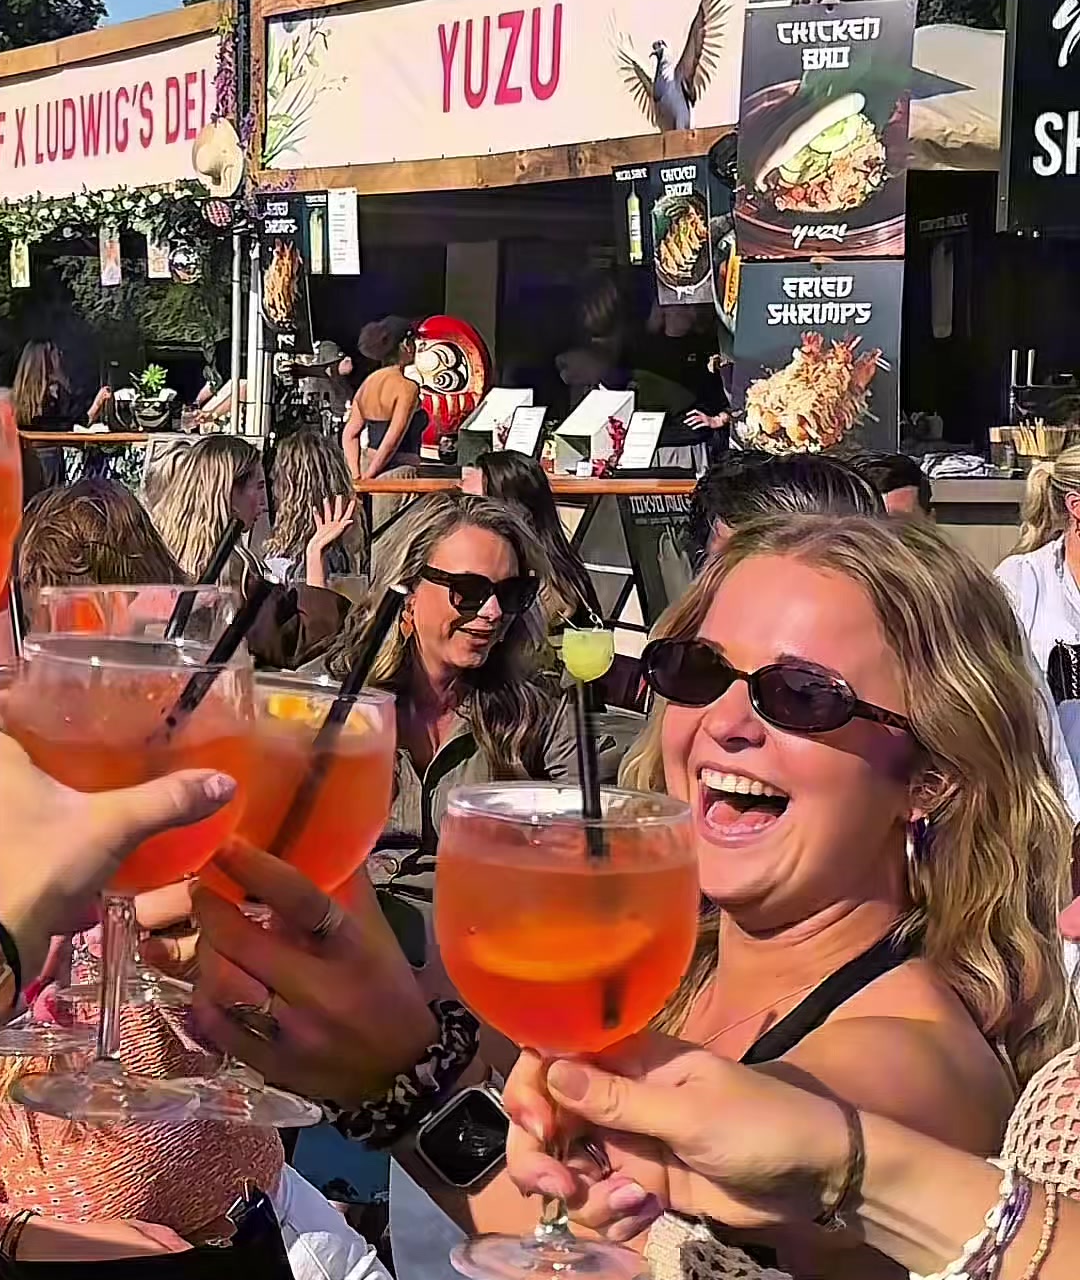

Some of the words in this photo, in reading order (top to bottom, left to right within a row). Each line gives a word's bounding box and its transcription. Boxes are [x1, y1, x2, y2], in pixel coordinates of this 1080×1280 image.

[777, 16, 880, 44] CHICKEN
[437, 3, 563, 113] YUZU
[801, 45, 850, 71] BAO
[14, 107, 26, 168] X
[35, 81, 153, 164] LUDWIG'S
[767, 302, 872, 325] SHRIMPS
